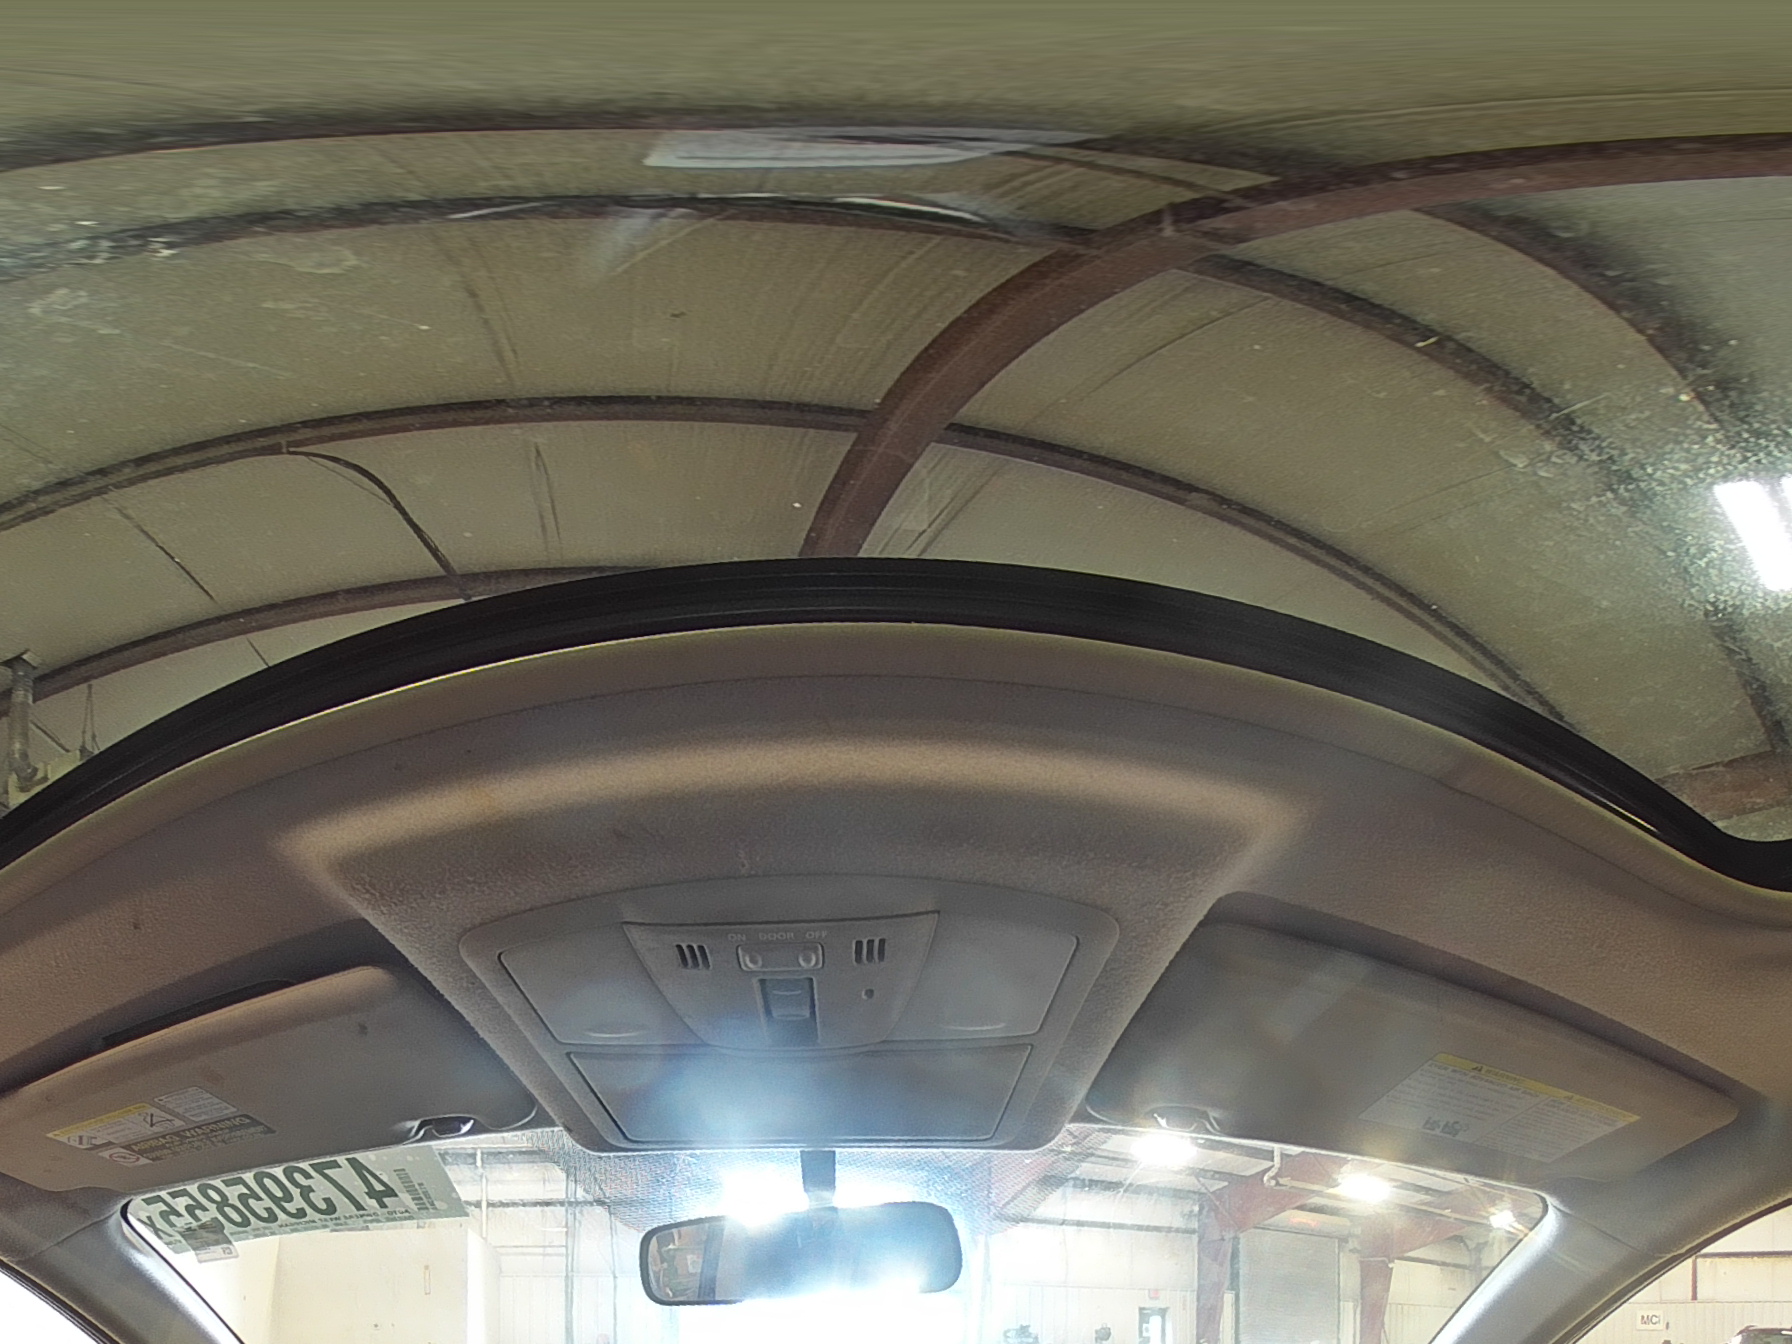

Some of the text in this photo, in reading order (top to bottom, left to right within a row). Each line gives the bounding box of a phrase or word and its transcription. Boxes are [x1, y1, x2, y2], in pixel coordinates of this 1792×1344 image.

[727, 930, 828, 941] ON DOOR OFF
[182, 1116, 251, 1138] WARNING
